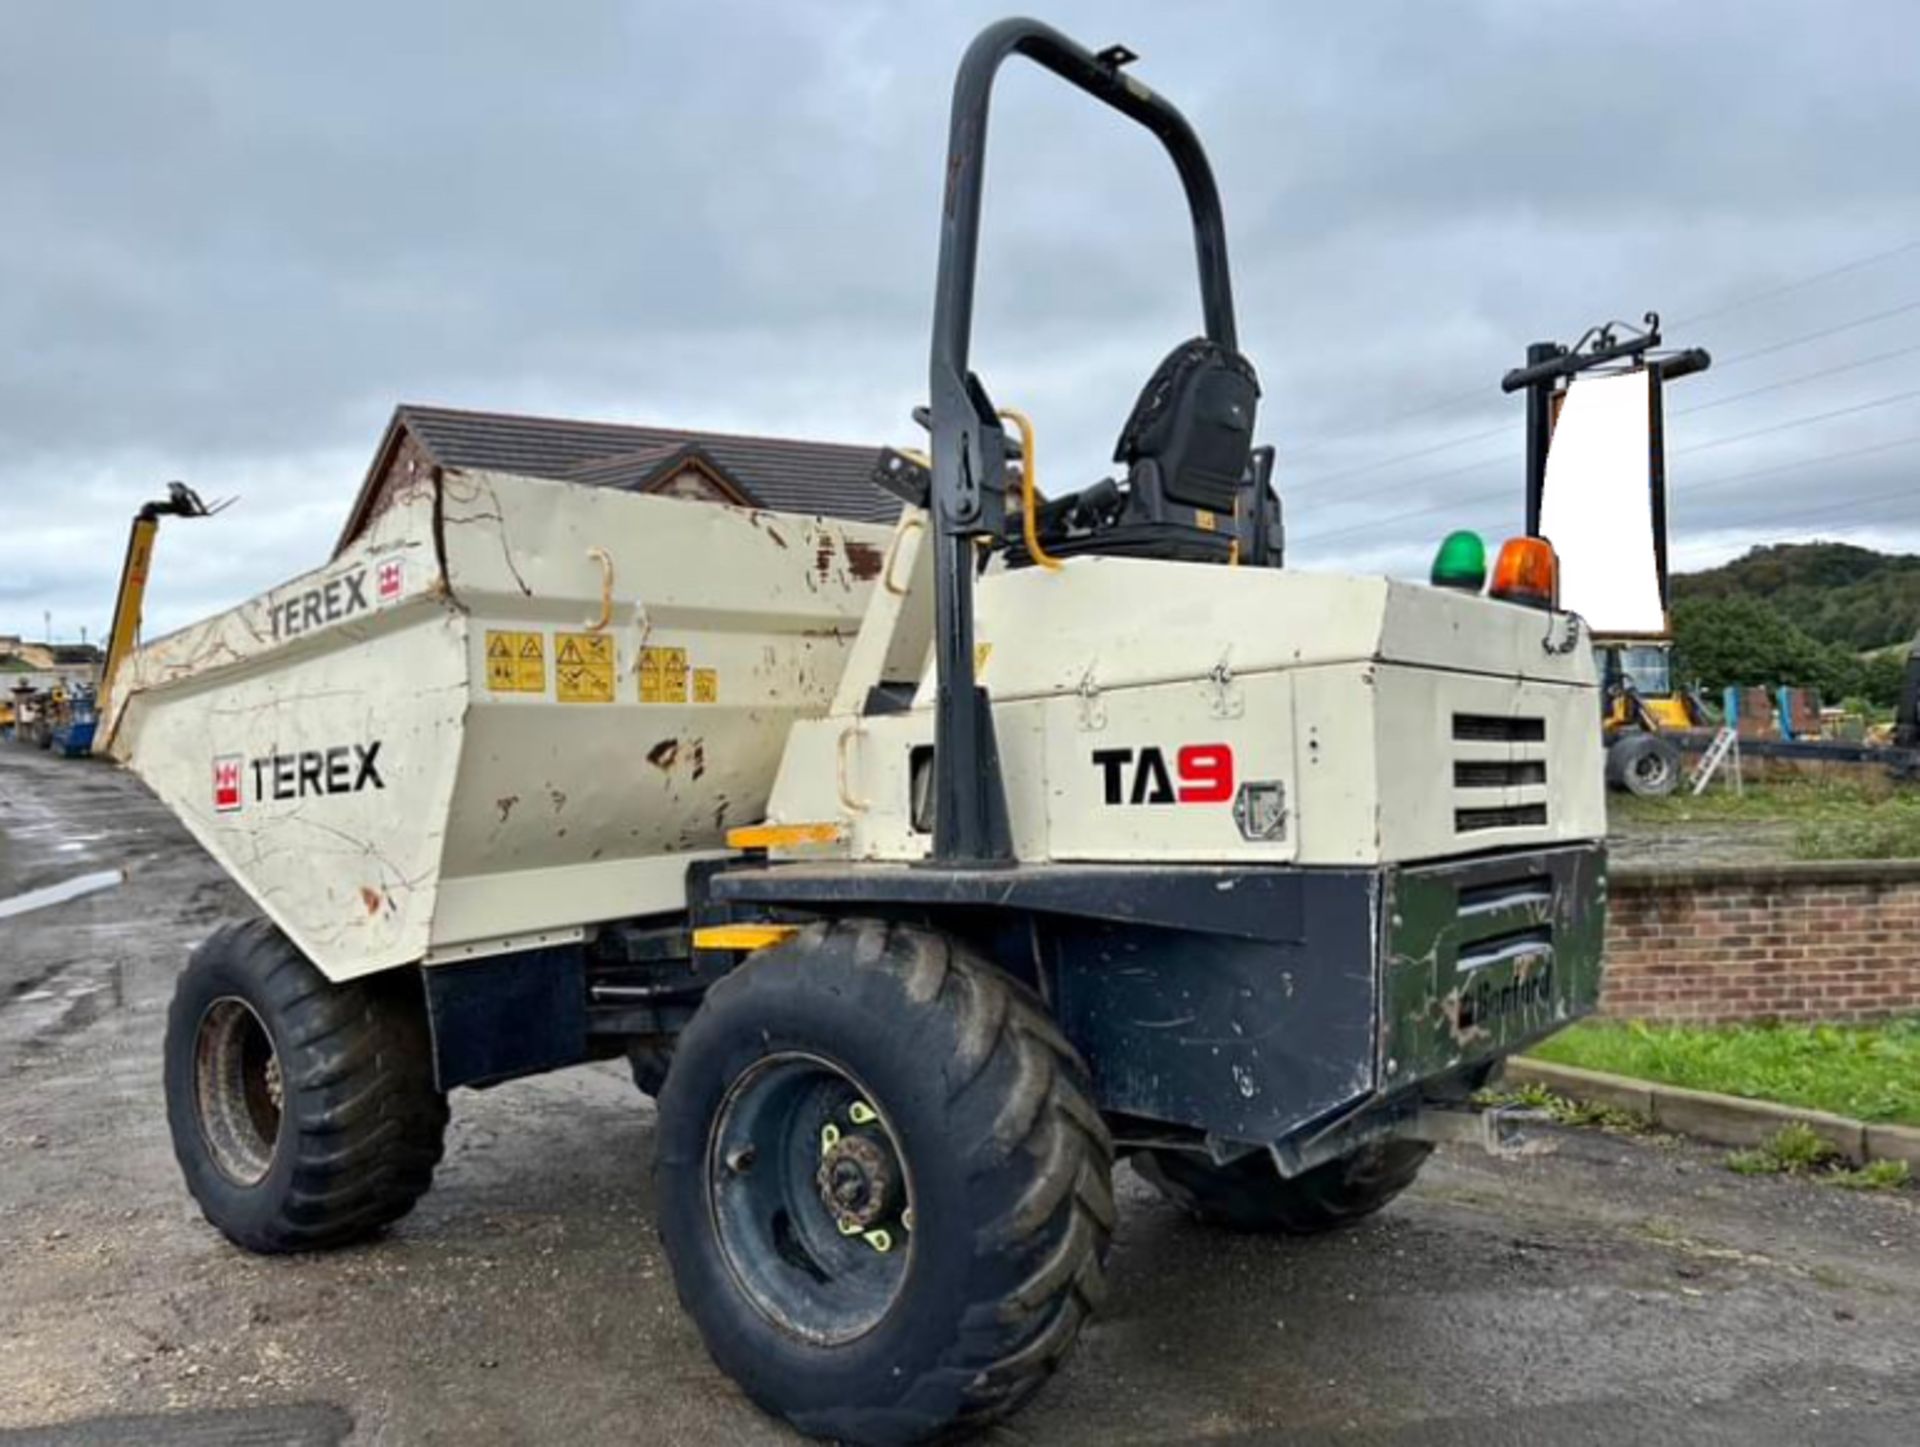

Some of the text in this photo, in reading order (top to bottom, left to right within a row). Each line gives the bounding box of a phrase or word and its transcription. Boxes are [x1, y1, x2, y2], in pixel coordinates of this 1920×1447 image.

[270, 569, 368, 641] TEREX
[251, 740, 386, 802] TEREX
[1092, 743, 1233, 805] TA9
